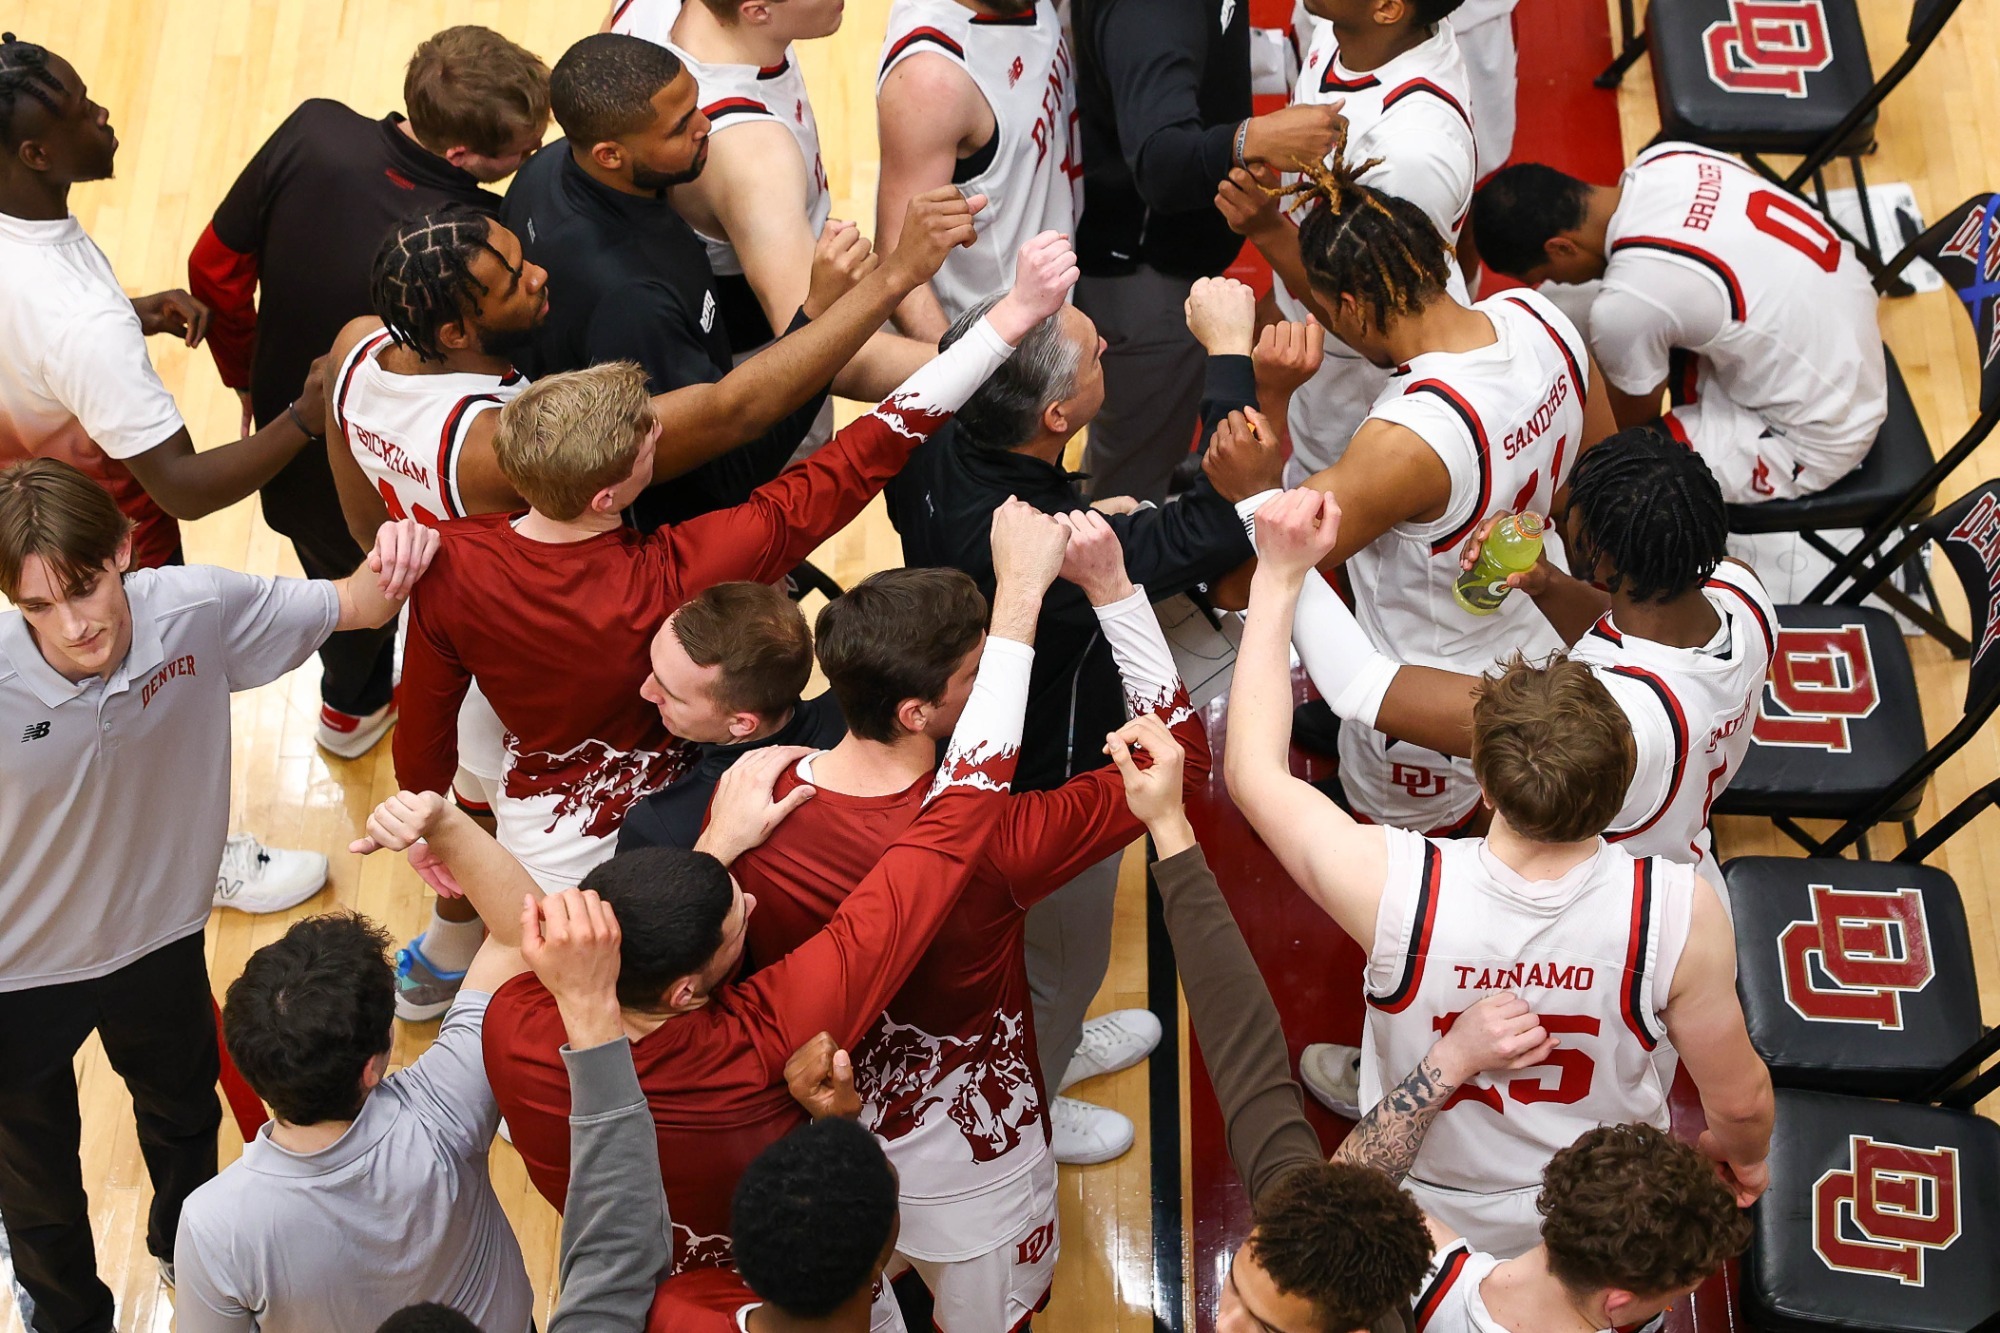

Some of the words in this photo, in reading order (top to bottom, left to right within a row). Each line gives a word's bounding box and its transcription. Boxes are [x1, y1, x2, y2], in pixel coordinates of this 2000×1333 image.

[1746, 189, 1841, 273] 0
[352, 422, 431, 491] BICKHAM
[141, 654, 196, 710] DENVER
[1454, 962, 1594, 991] TAINAMO
